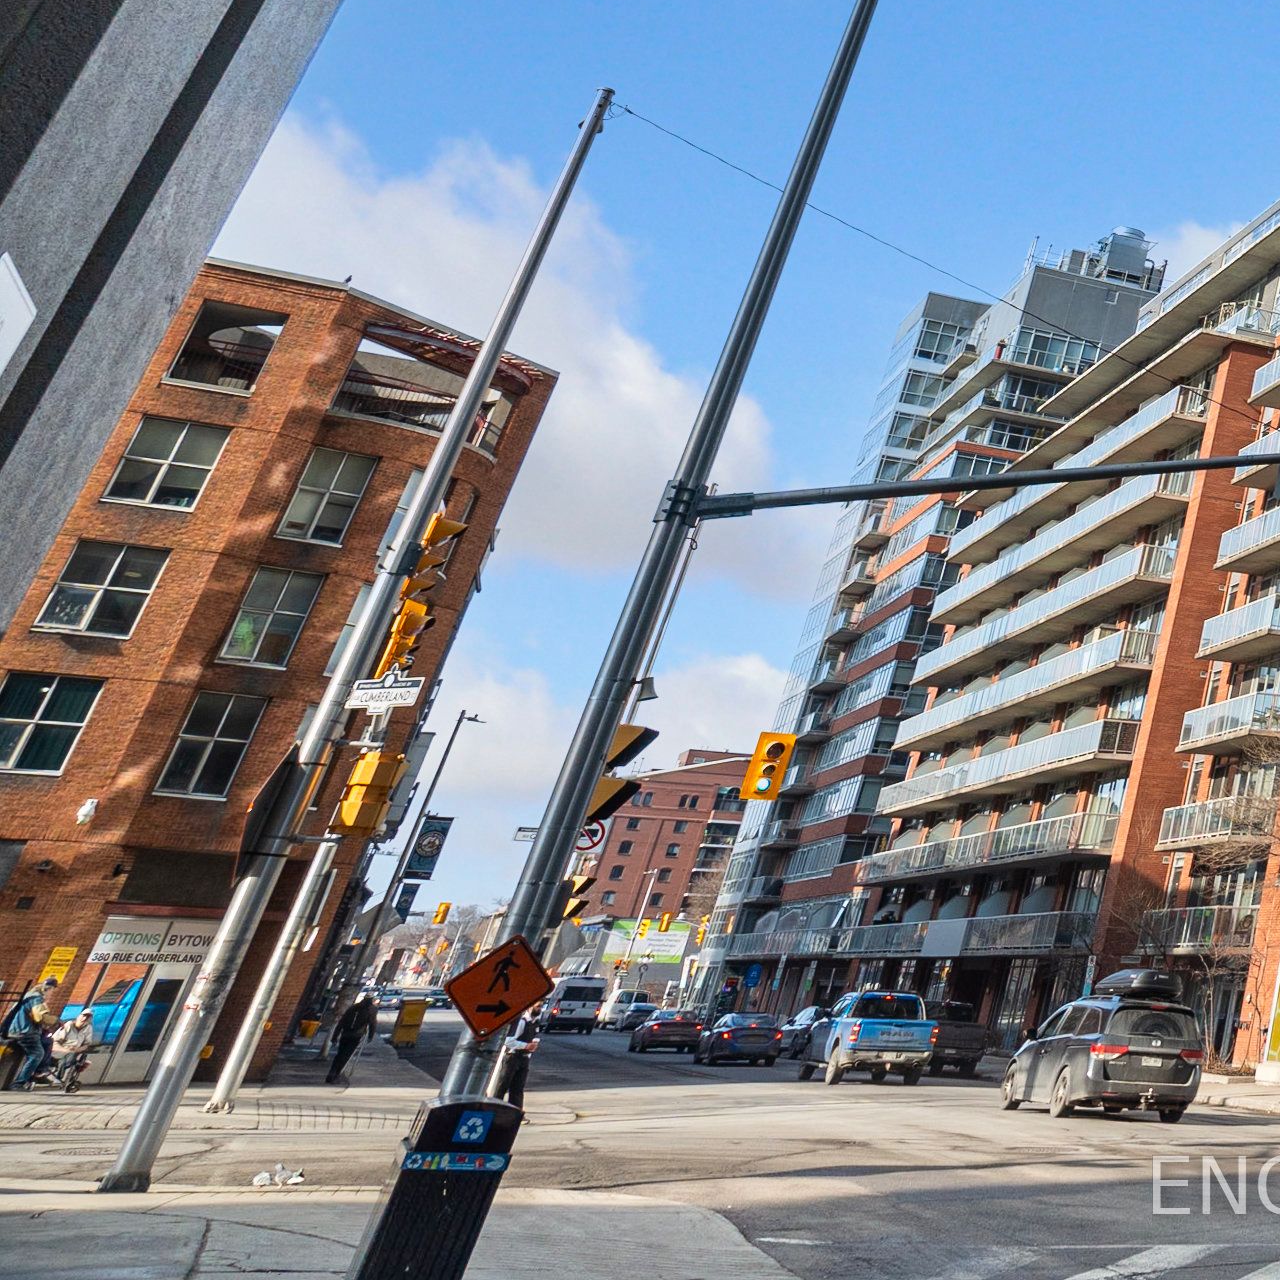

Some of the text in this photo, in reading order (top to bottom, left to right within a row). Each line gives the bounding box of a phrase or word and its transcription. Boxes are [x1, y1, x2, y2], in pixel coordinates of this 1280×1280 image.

[102, 931, 213, 947] OPTIONS BYTOW
[91, 952, 203, 964] 380 RUE CUMBERLAND
